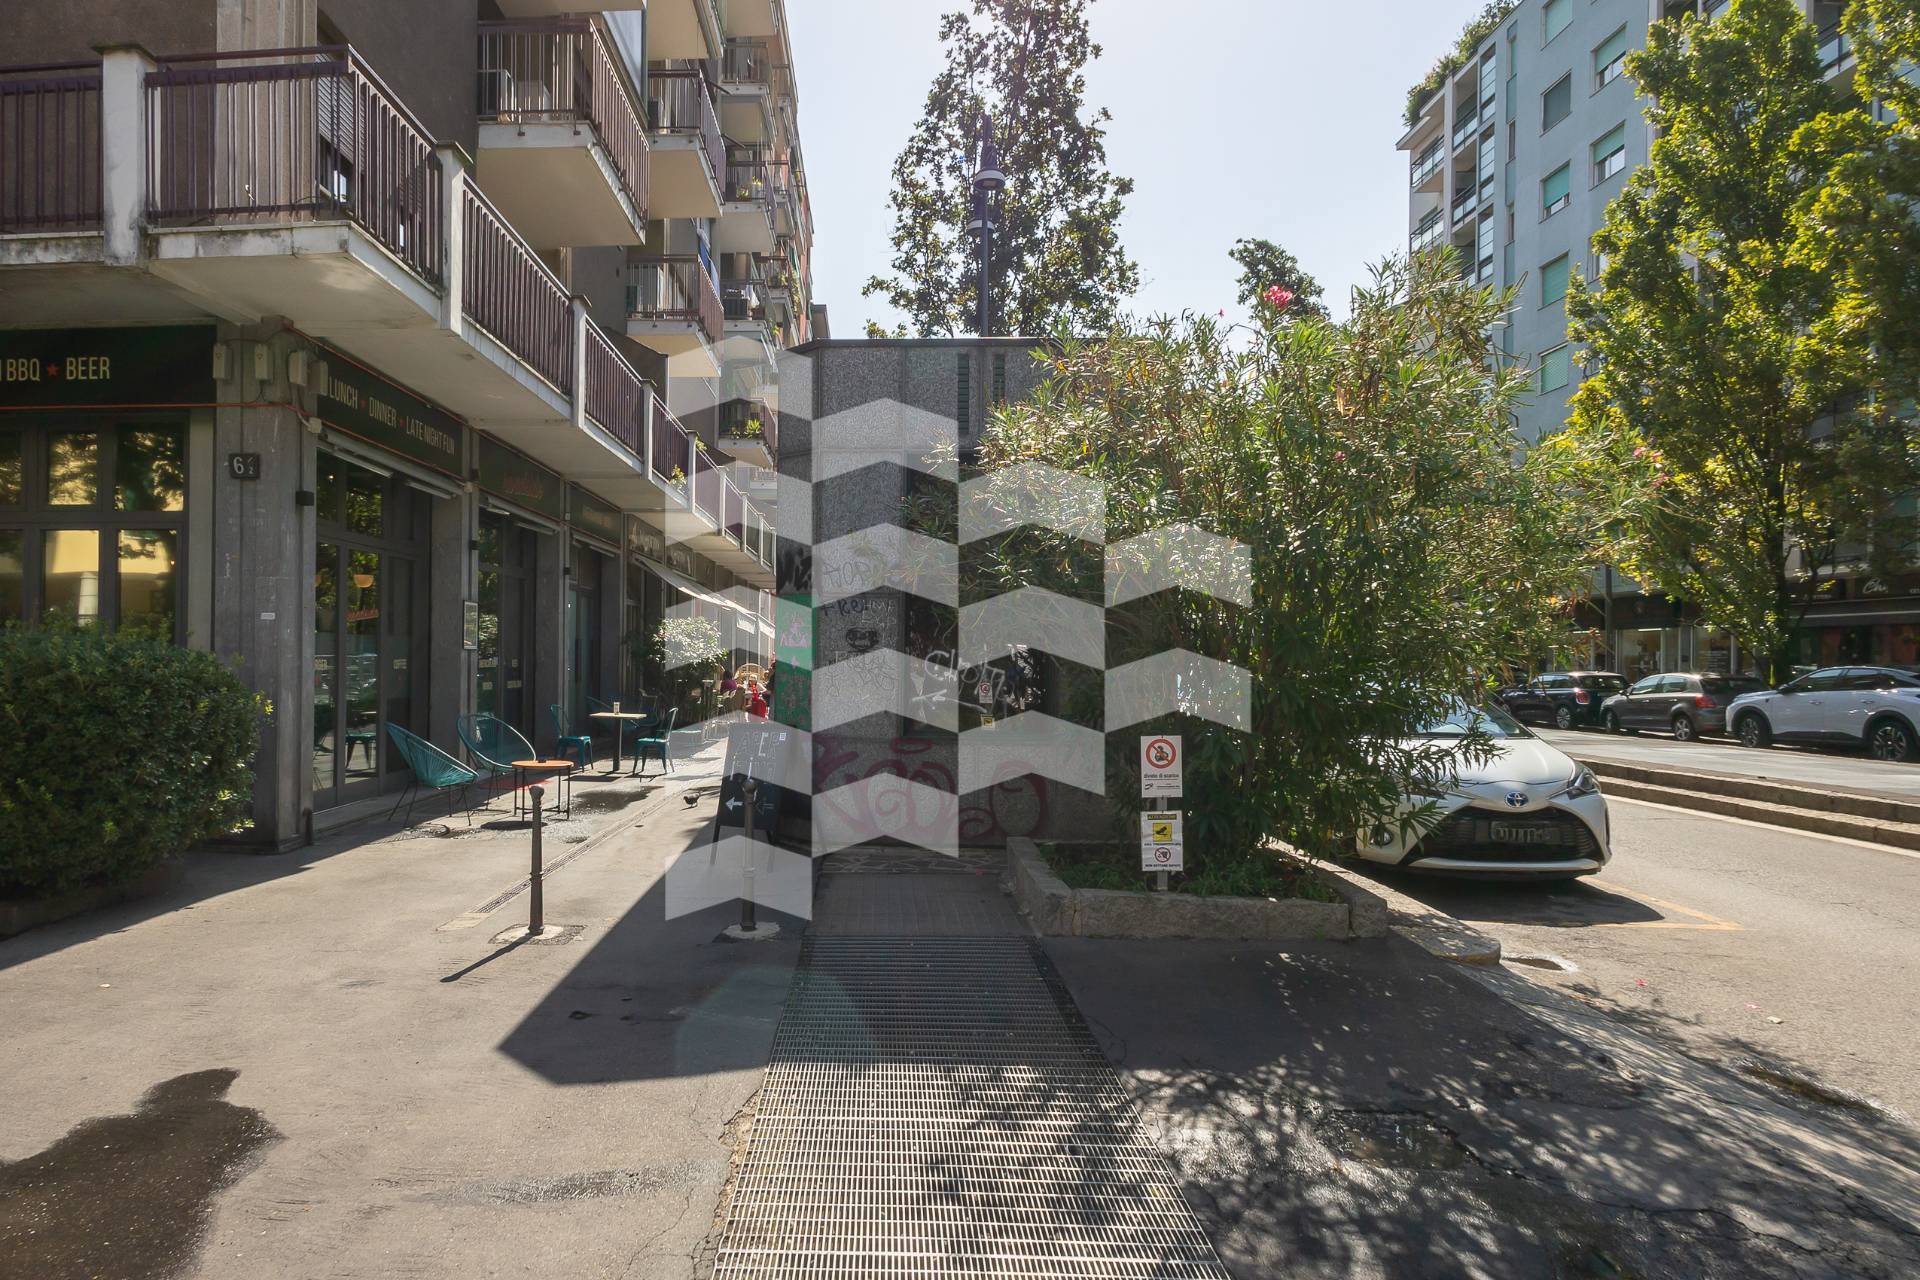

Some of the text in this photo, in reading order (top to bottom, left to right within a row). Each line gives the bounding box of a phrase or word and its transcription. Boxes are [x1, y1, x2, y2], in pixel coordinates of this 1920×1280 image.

[6, 358, 41, 382] BBQ
[66, 356, 111, 380] BEER
[329, 375, 456, 457] LUNCH DINNER LATE NIGHT FUN
